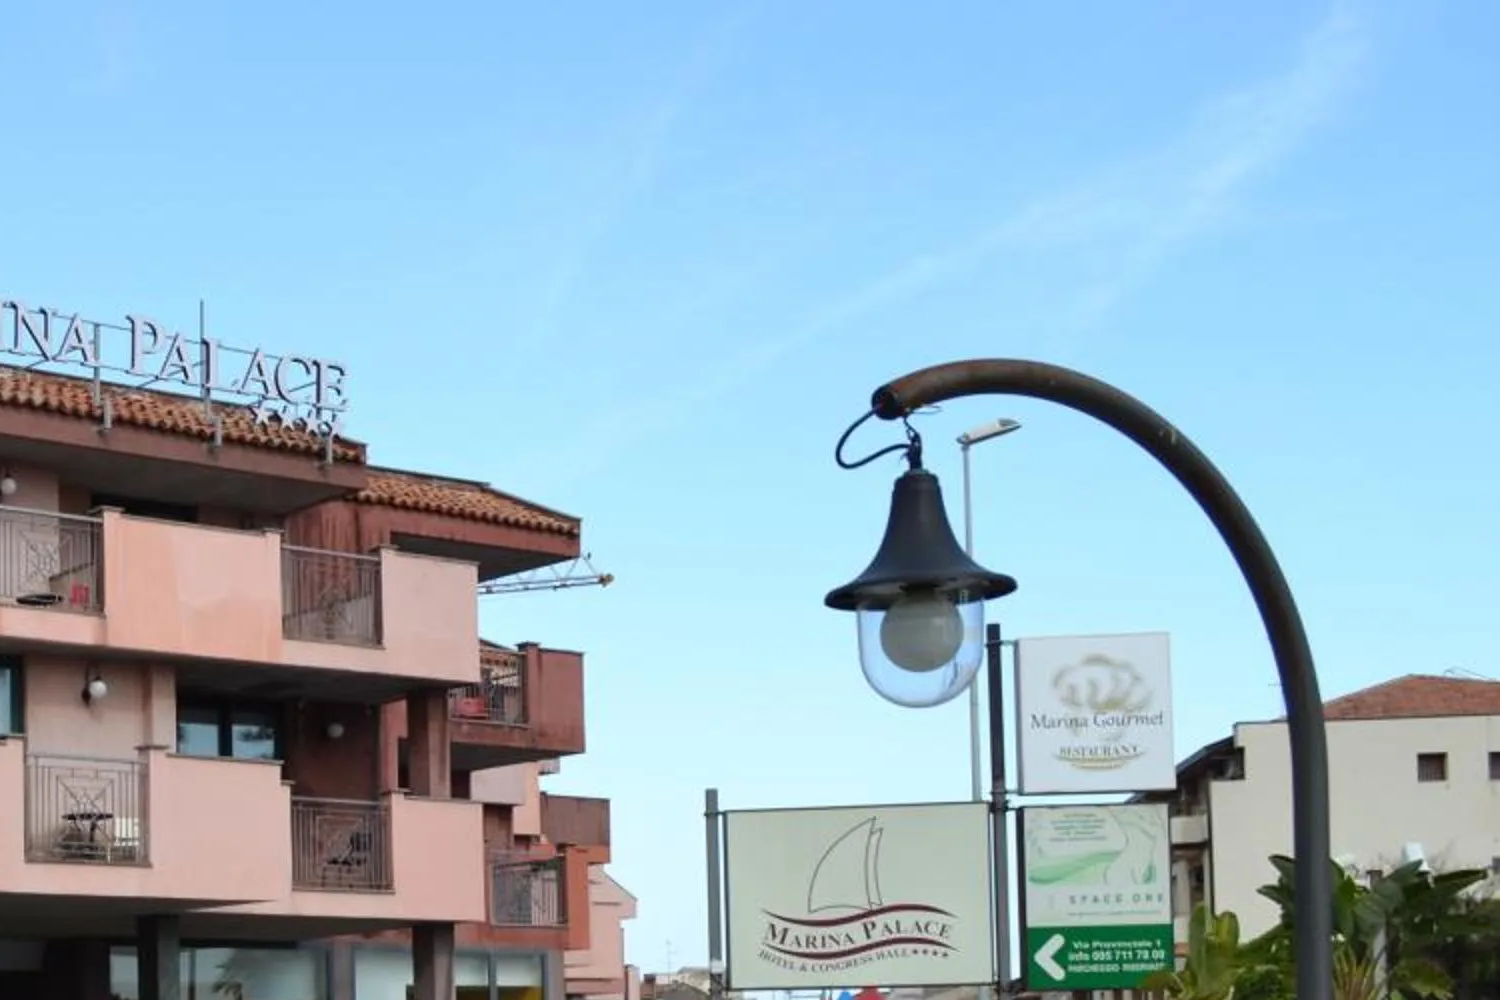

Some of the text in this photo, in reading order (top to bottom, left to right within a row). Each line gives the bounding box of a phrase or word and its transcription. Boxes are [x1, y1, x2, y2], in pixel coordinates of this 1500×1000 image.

[125, 314, 350, 412] PALACE
[1030, 710, 1164, 729] Marina Gourmet
[765, 919, 952, 950] MARINA PALACE
[757, 949, 796, 971] HOTEL
